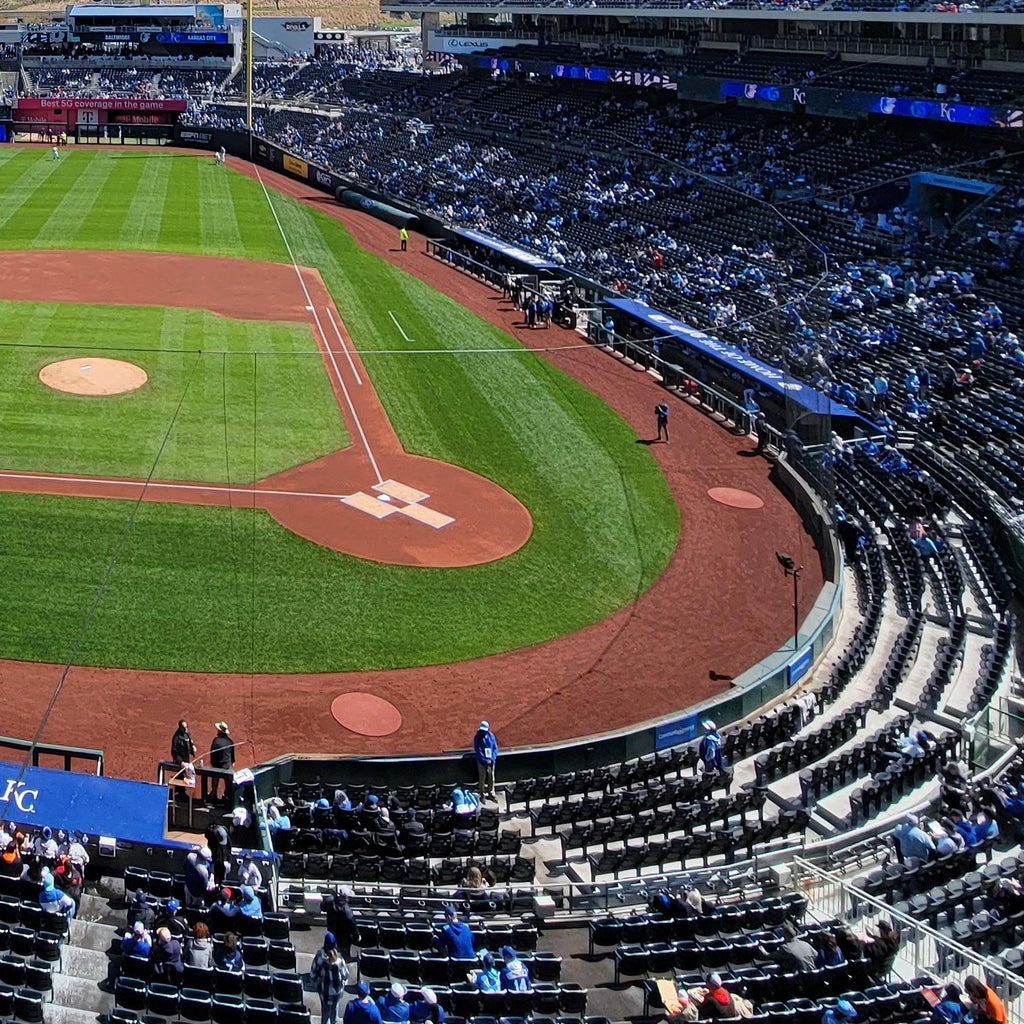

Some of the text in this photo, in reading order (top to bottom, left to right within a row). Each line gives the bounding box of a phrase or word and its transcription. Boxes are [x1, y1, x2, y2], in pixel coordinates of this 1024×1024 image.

[75, 100, 112, 109] coverage
[115, 99, 122, 107] in
[124, 100, 137, 108] the
[793, 88, 807, 105] KC
[940, 103, 956, 122] KC
[0, 779, 39, 814] KC
